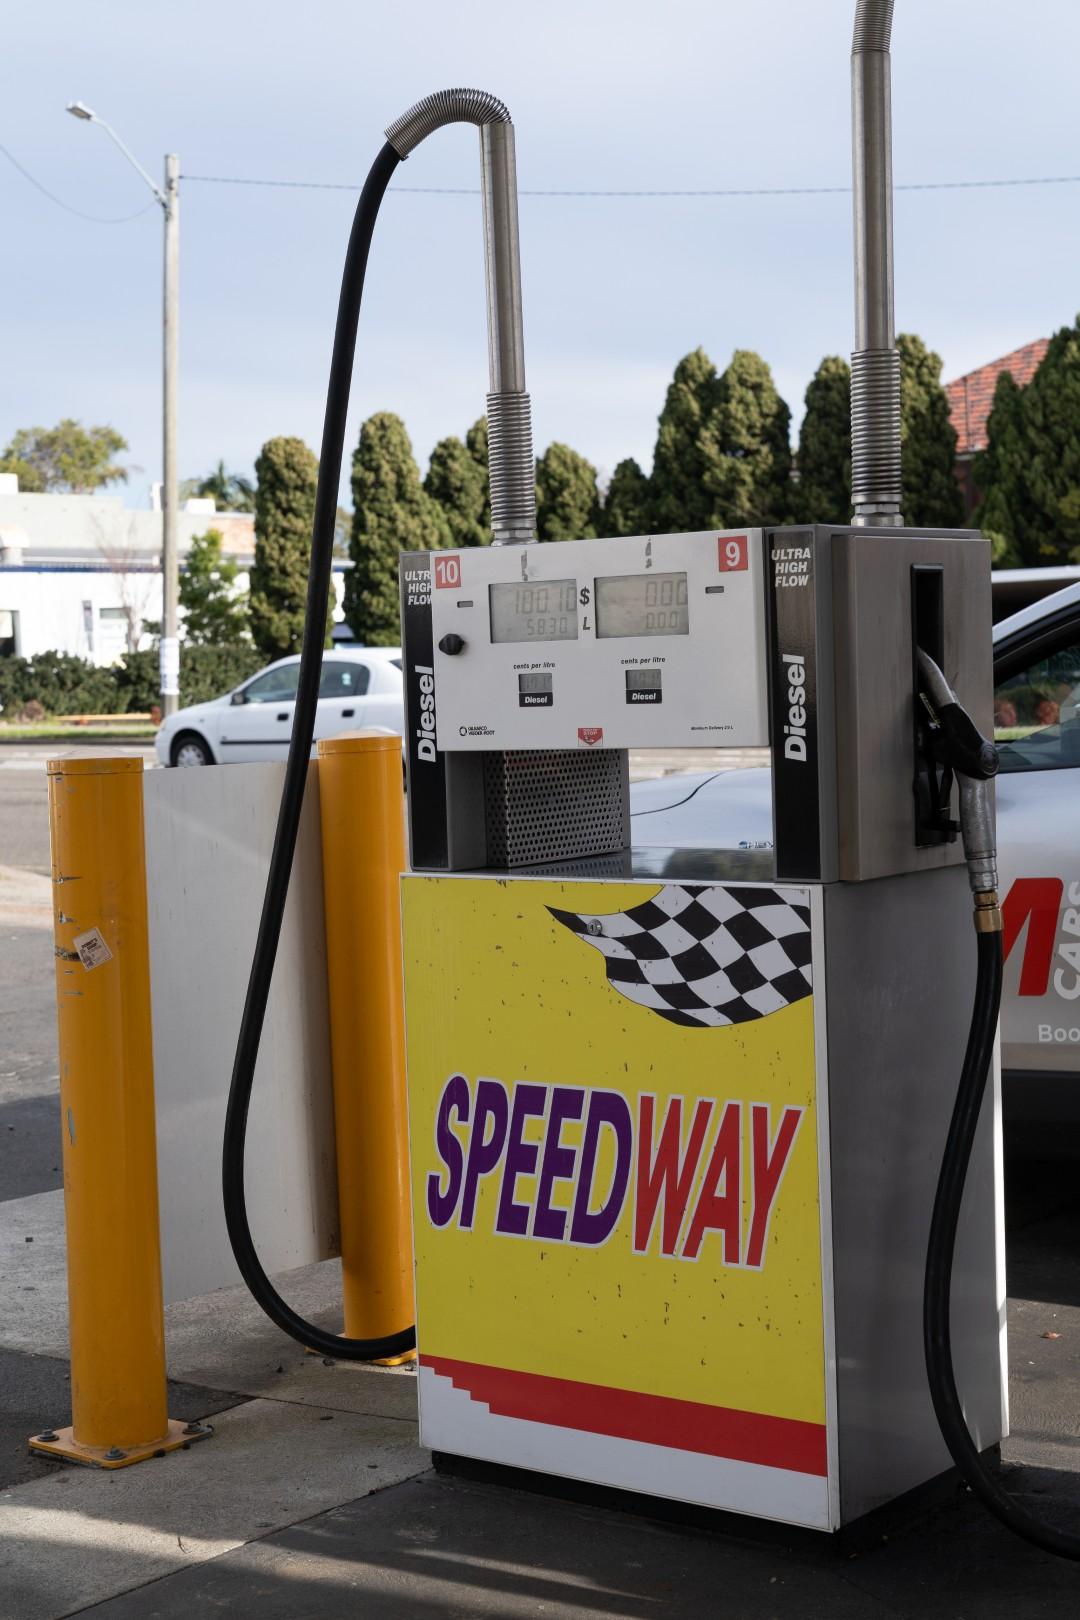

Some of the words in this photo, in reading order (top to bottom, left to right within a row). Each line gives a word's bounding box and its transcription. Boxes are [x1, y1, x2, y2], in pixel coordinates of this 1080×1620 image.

[725, 541, 742, 567] 9
[771, 548, 811, 561] ULTRA
[437, 560, 459, 584] 10
[775, 561, 808, 574] HIGH
[405, 571, 432, 582] ULTR
[775, 575, 809, 588] FLOW
[579, 586, 591, 607] $
[583, 616, 591, 631] L
[524, 696, 548, 704] Diesel
[631, 692, 657, 700] Diesel
[414, 665, 437, 762] Diesel
[782, 653, 808, 762] Diesel
[426, 1072, 805, 1271] SPEEDWAY
